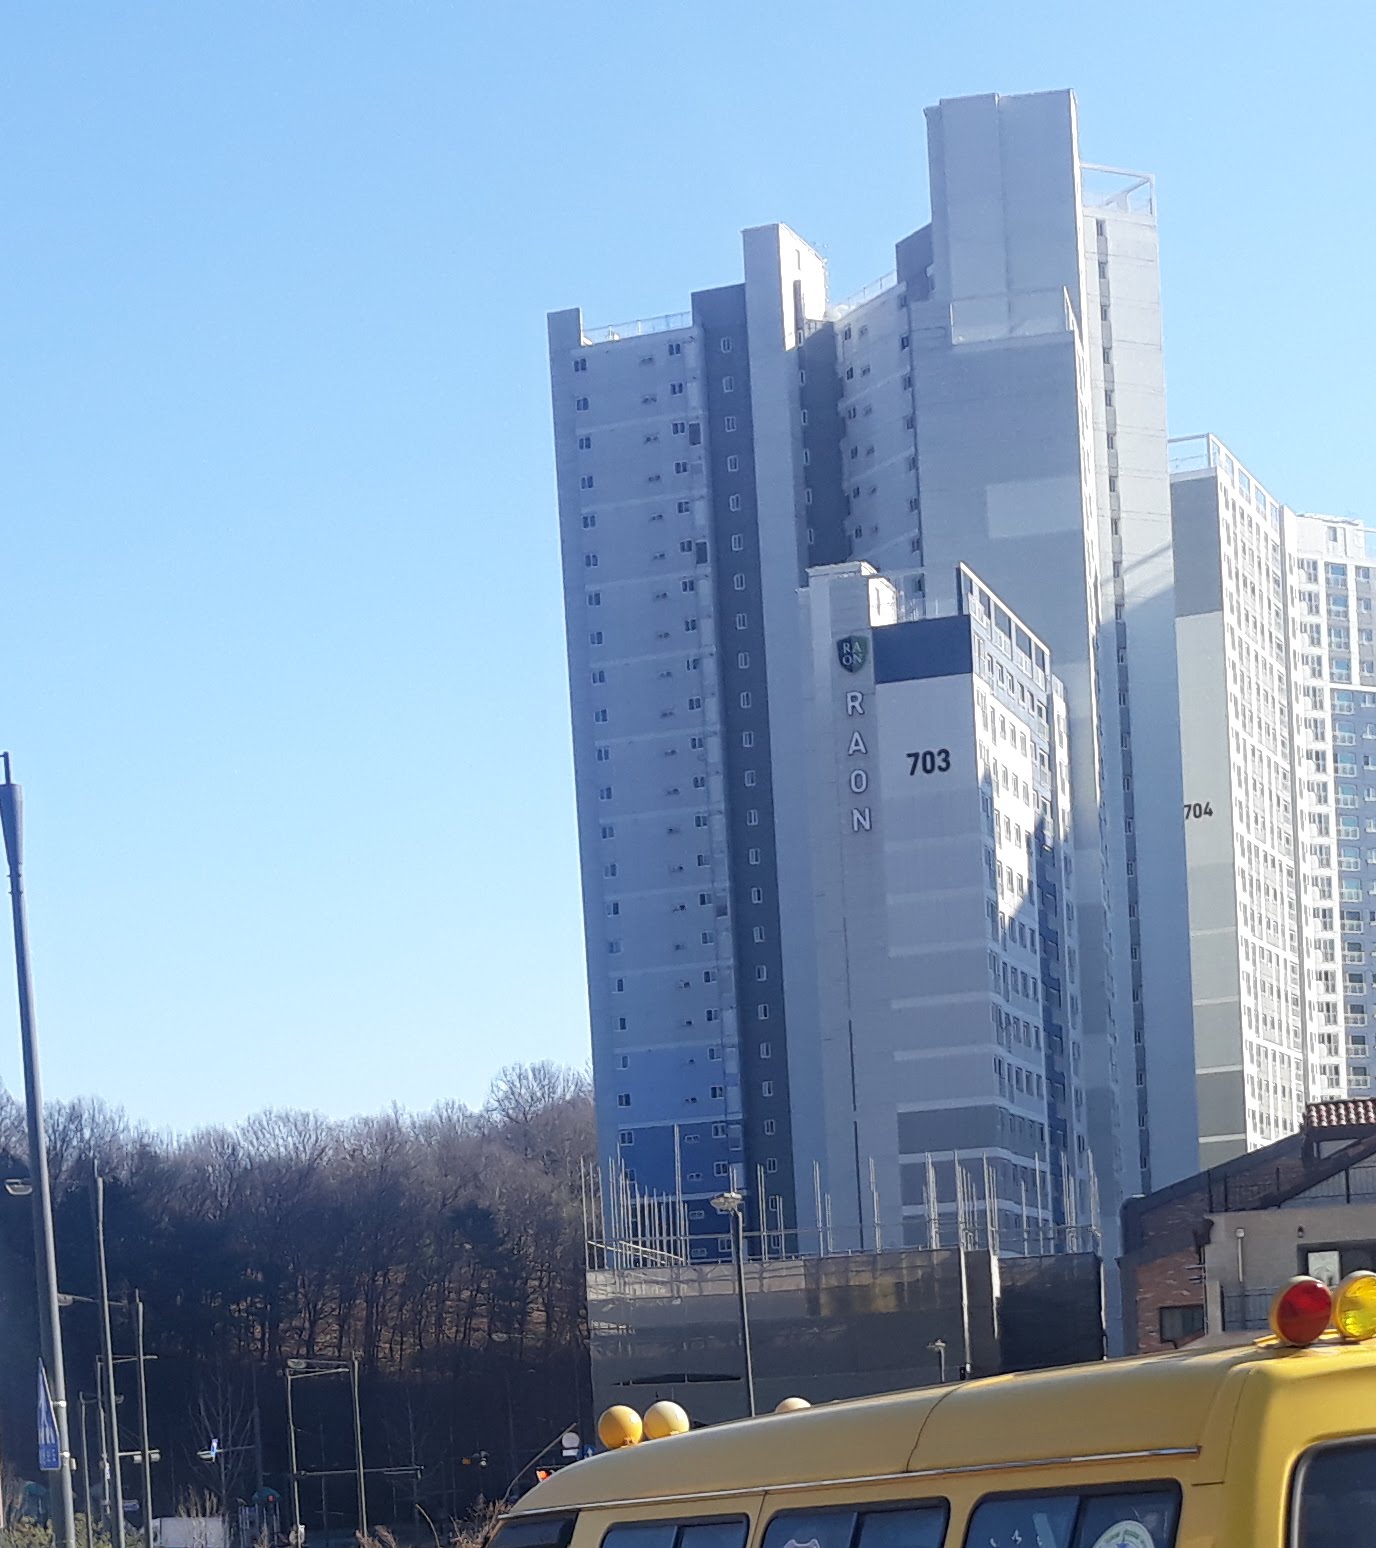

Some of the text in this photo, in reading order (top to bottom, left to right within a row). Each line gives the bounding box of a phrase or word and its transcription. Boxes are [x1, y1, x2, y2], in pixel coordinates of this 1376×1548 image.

[846, 690, 873, 833] RAON
[905, 748, 952, 776] 703
[1183, 802, 1214, 821] 704
